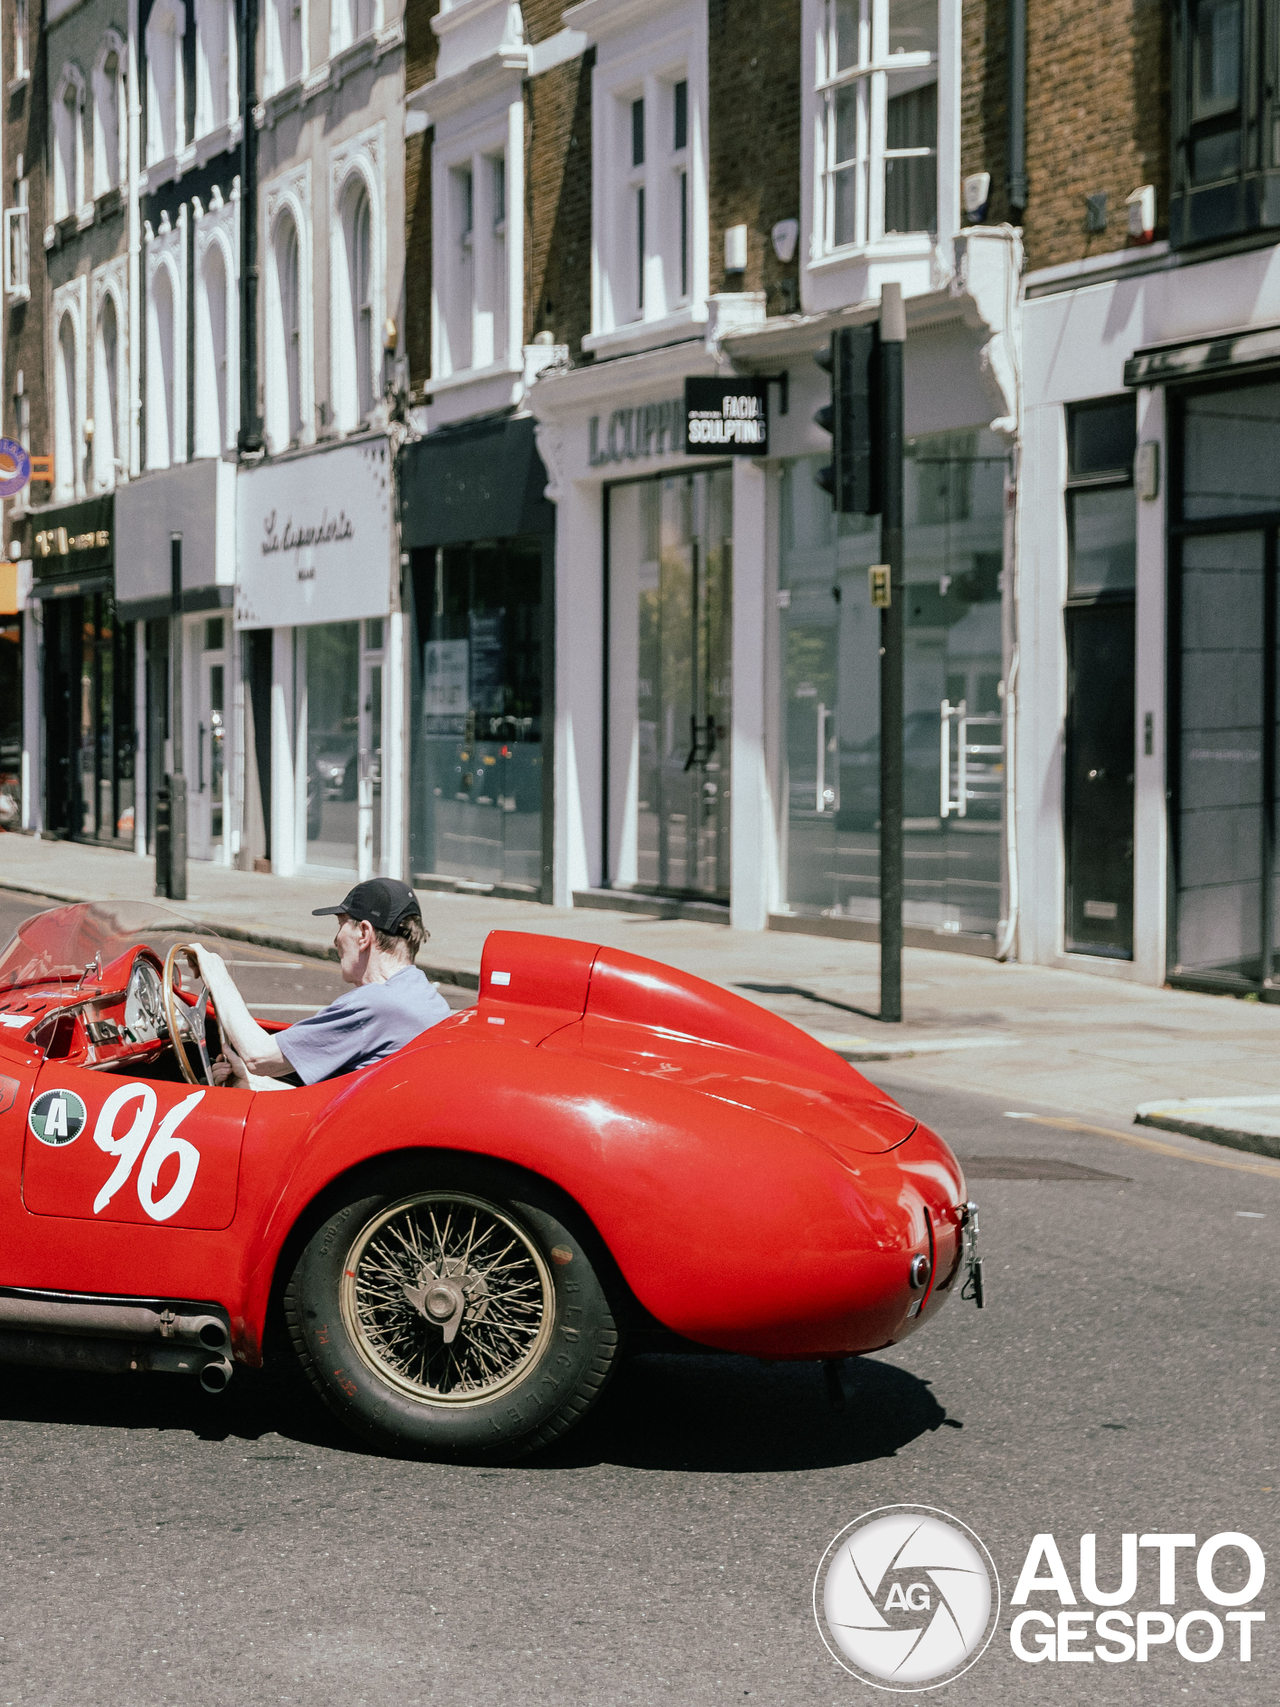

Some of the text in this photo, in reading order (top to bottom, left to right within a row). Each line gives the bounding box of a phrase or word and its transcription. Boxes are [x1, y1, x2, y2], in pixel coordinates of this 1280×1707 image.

[723, 396, 764, 419] FACIAL
[688, 420, 766, 443] SCULPTING
[44, 1098, 68, 1137] A
[93, 1082, 206, 1221] 96
